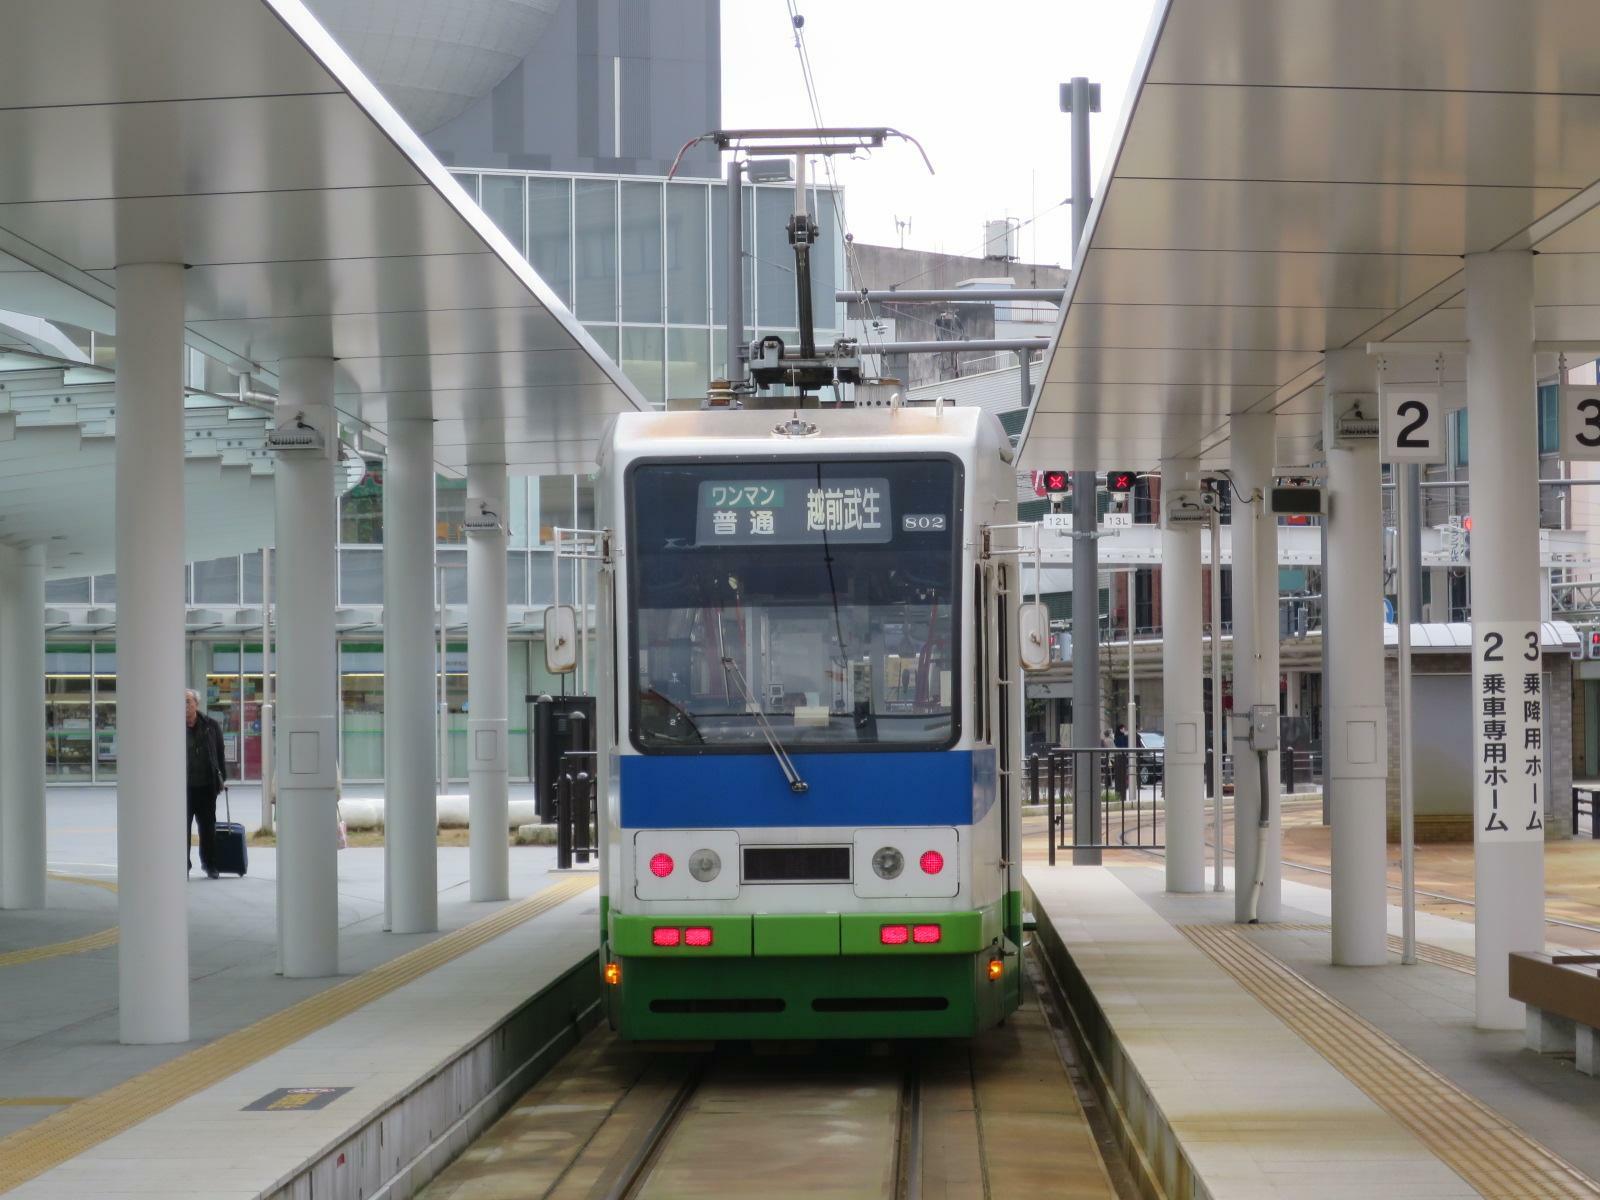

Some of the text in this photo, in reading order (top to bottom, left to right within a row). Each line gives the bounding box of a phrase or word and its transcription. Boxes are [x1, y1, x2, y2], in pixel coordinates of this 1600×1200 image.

[1397, 400, 1430, 447] 2
[1575, 399, 1600, 447] 3
[712, 486, 775, 506] ワンマン
[806, 487, 881, 531] 越前武生
[712, 510, 775, 535] 普通
[905, 516, 944, 529] 802
[1048, 517, 1069, 526] 12L
[1108, 517, 1129, 526] 13L
[1482, 632, 1509, 832] 2 乗車専用ホーム
[1523, 631, 1543, 831] 3 乗降用ホーム
